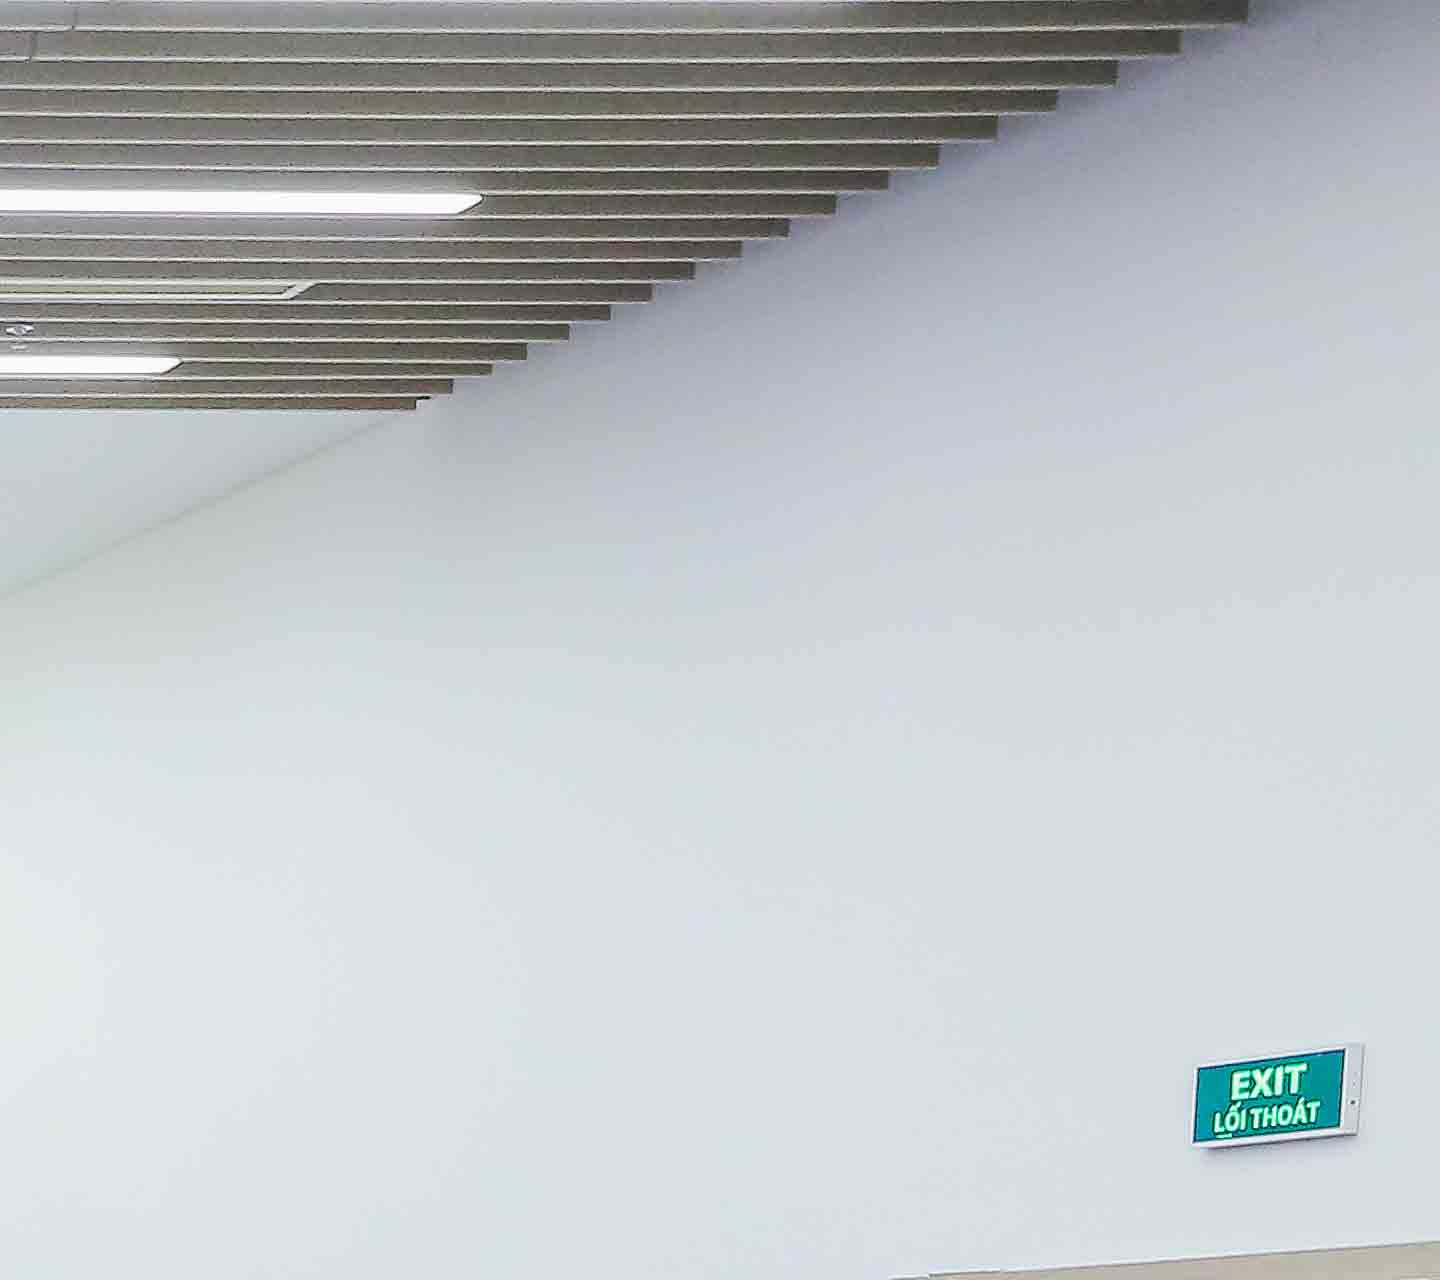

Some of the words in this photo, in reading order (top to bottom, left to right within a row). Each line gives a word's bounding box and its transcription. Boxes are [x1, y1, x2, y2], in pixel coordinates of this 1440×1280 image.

[1231, 1063, 1308, 1101] EXIT
[1213, 1101, 1247, 1133] LỐI
[1249, 1097, 1321, 1129] THOÁT
